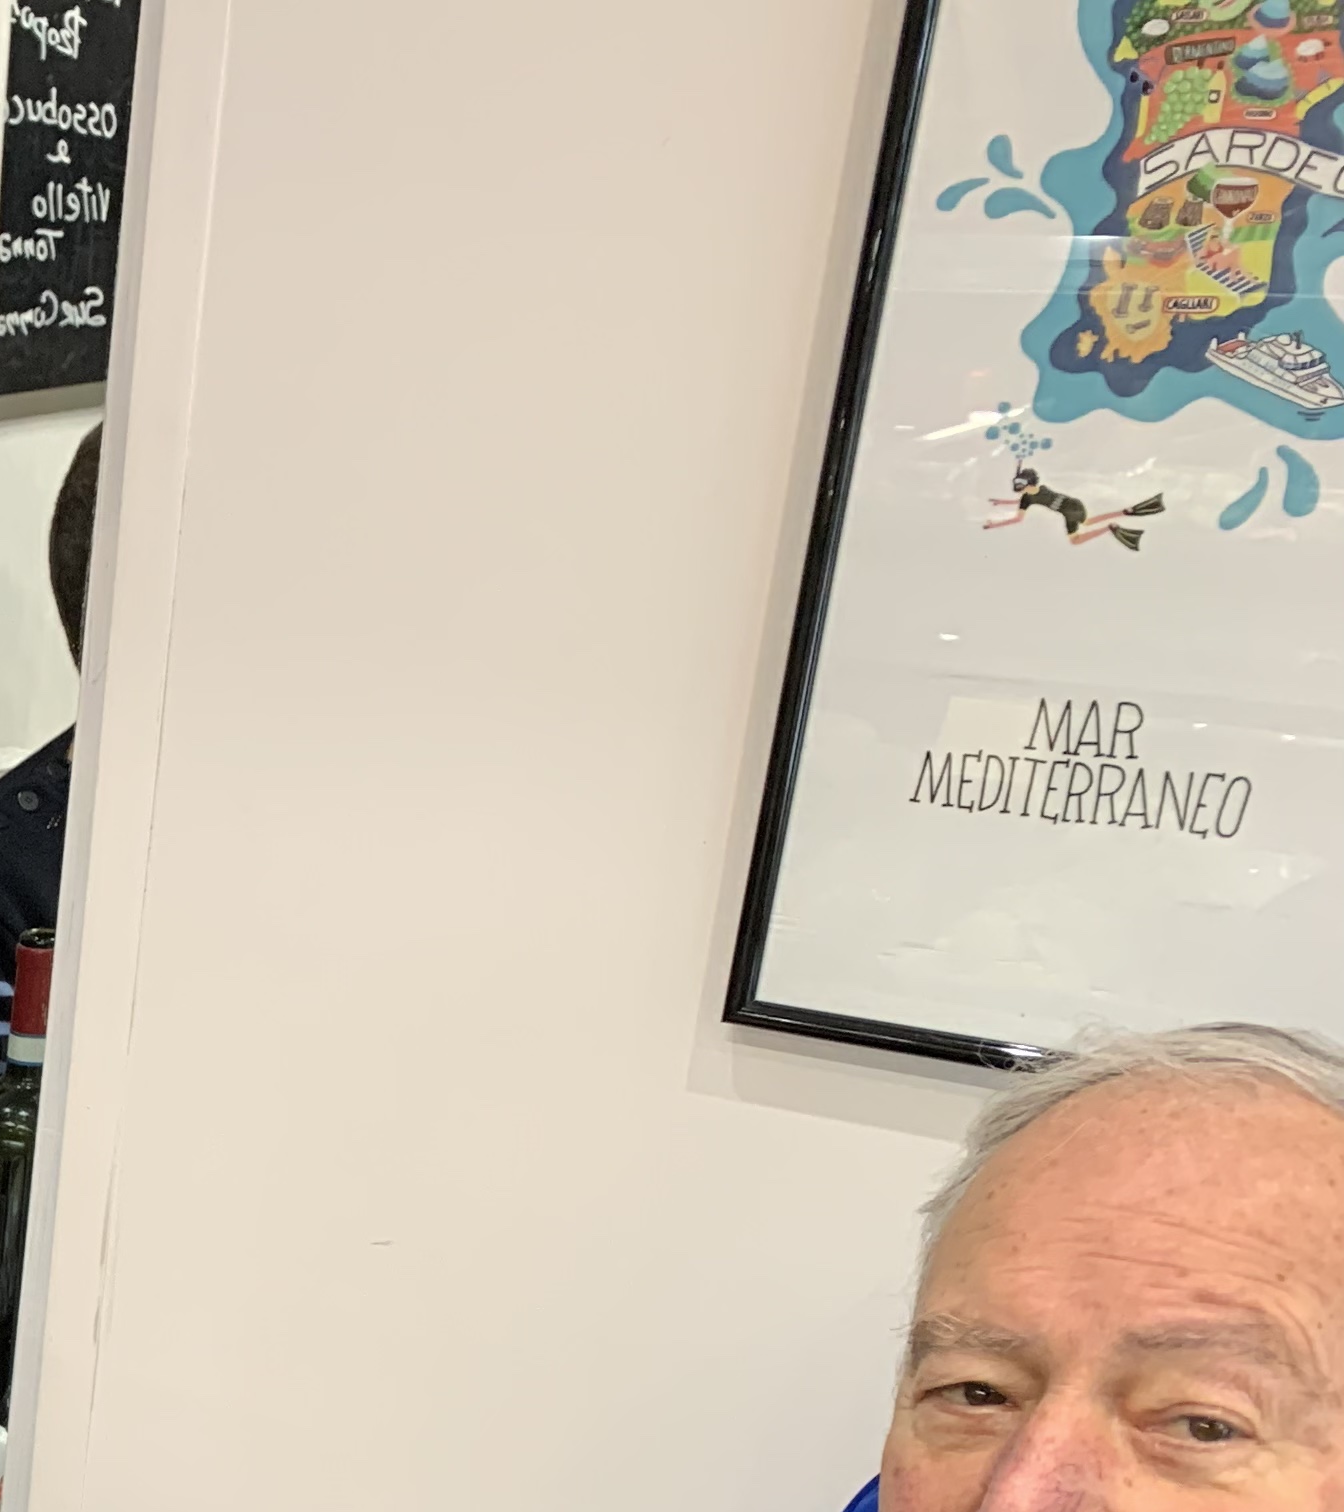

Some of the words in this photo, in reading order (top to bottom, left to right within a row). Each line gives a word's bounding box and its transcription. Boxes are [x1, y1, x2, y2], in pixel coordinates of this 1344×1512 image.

[1143, 130, 1344, 194] SARDE
[1024, 697, 1145, 760] MAR
[909, 750, 1253, 839] MEDITERRANEO
